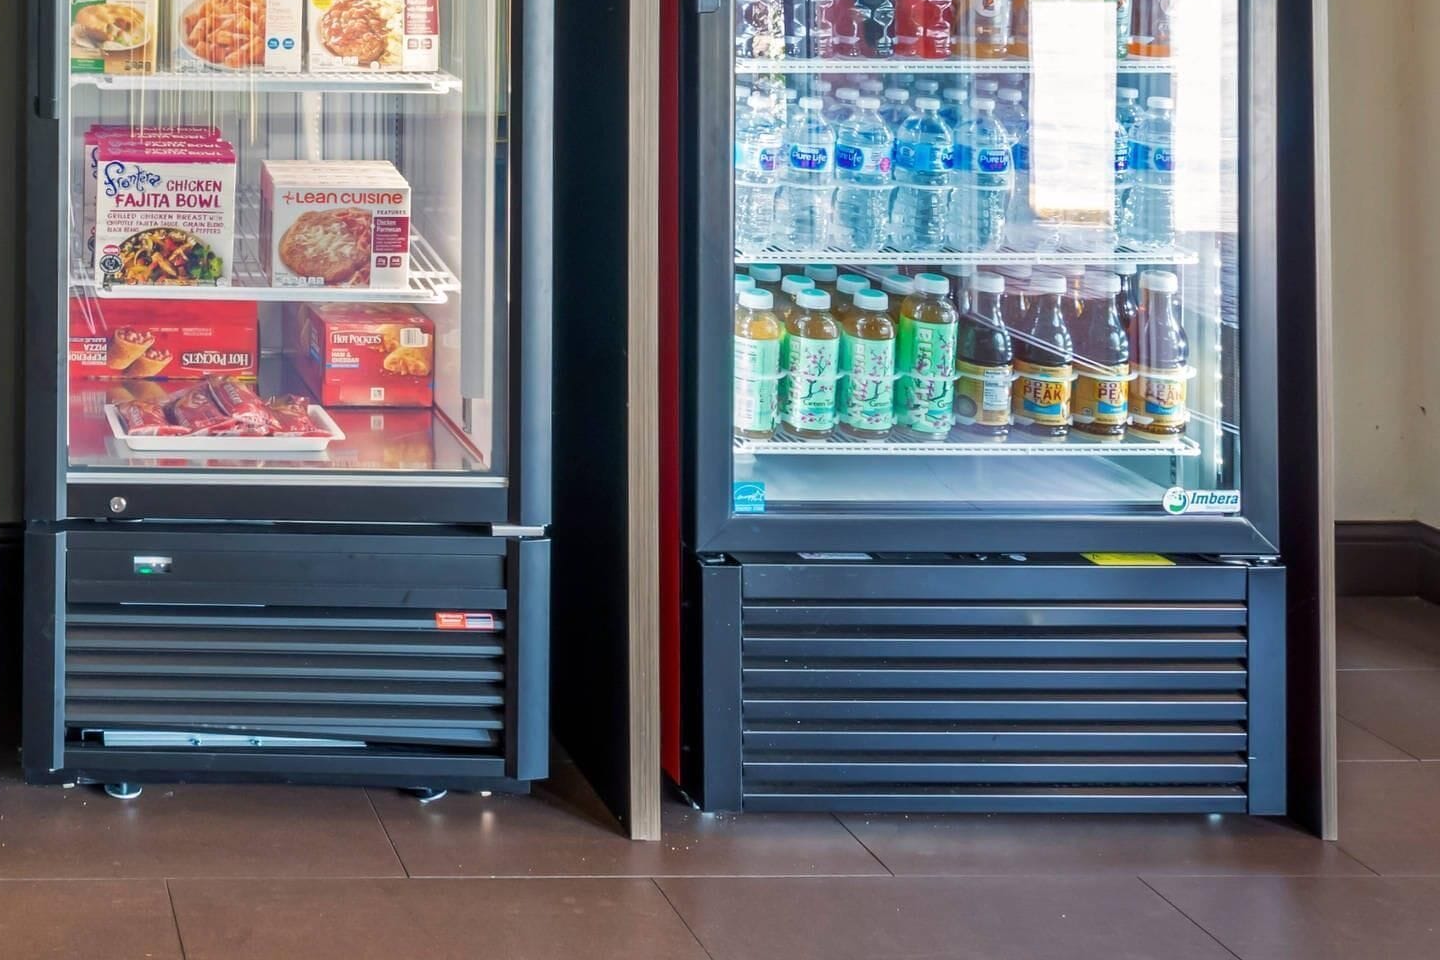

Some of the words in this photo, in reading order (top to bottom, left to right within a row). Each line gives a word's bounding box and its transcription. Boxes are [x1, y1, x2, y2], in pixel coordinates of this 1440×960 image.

[166, 180, 222, 193] CHICKEN
[115, 193, 170, 209] FAJITA
[176, 193, 221, 209] BOWL
[1191, 491, 1239, 506] Imbera
